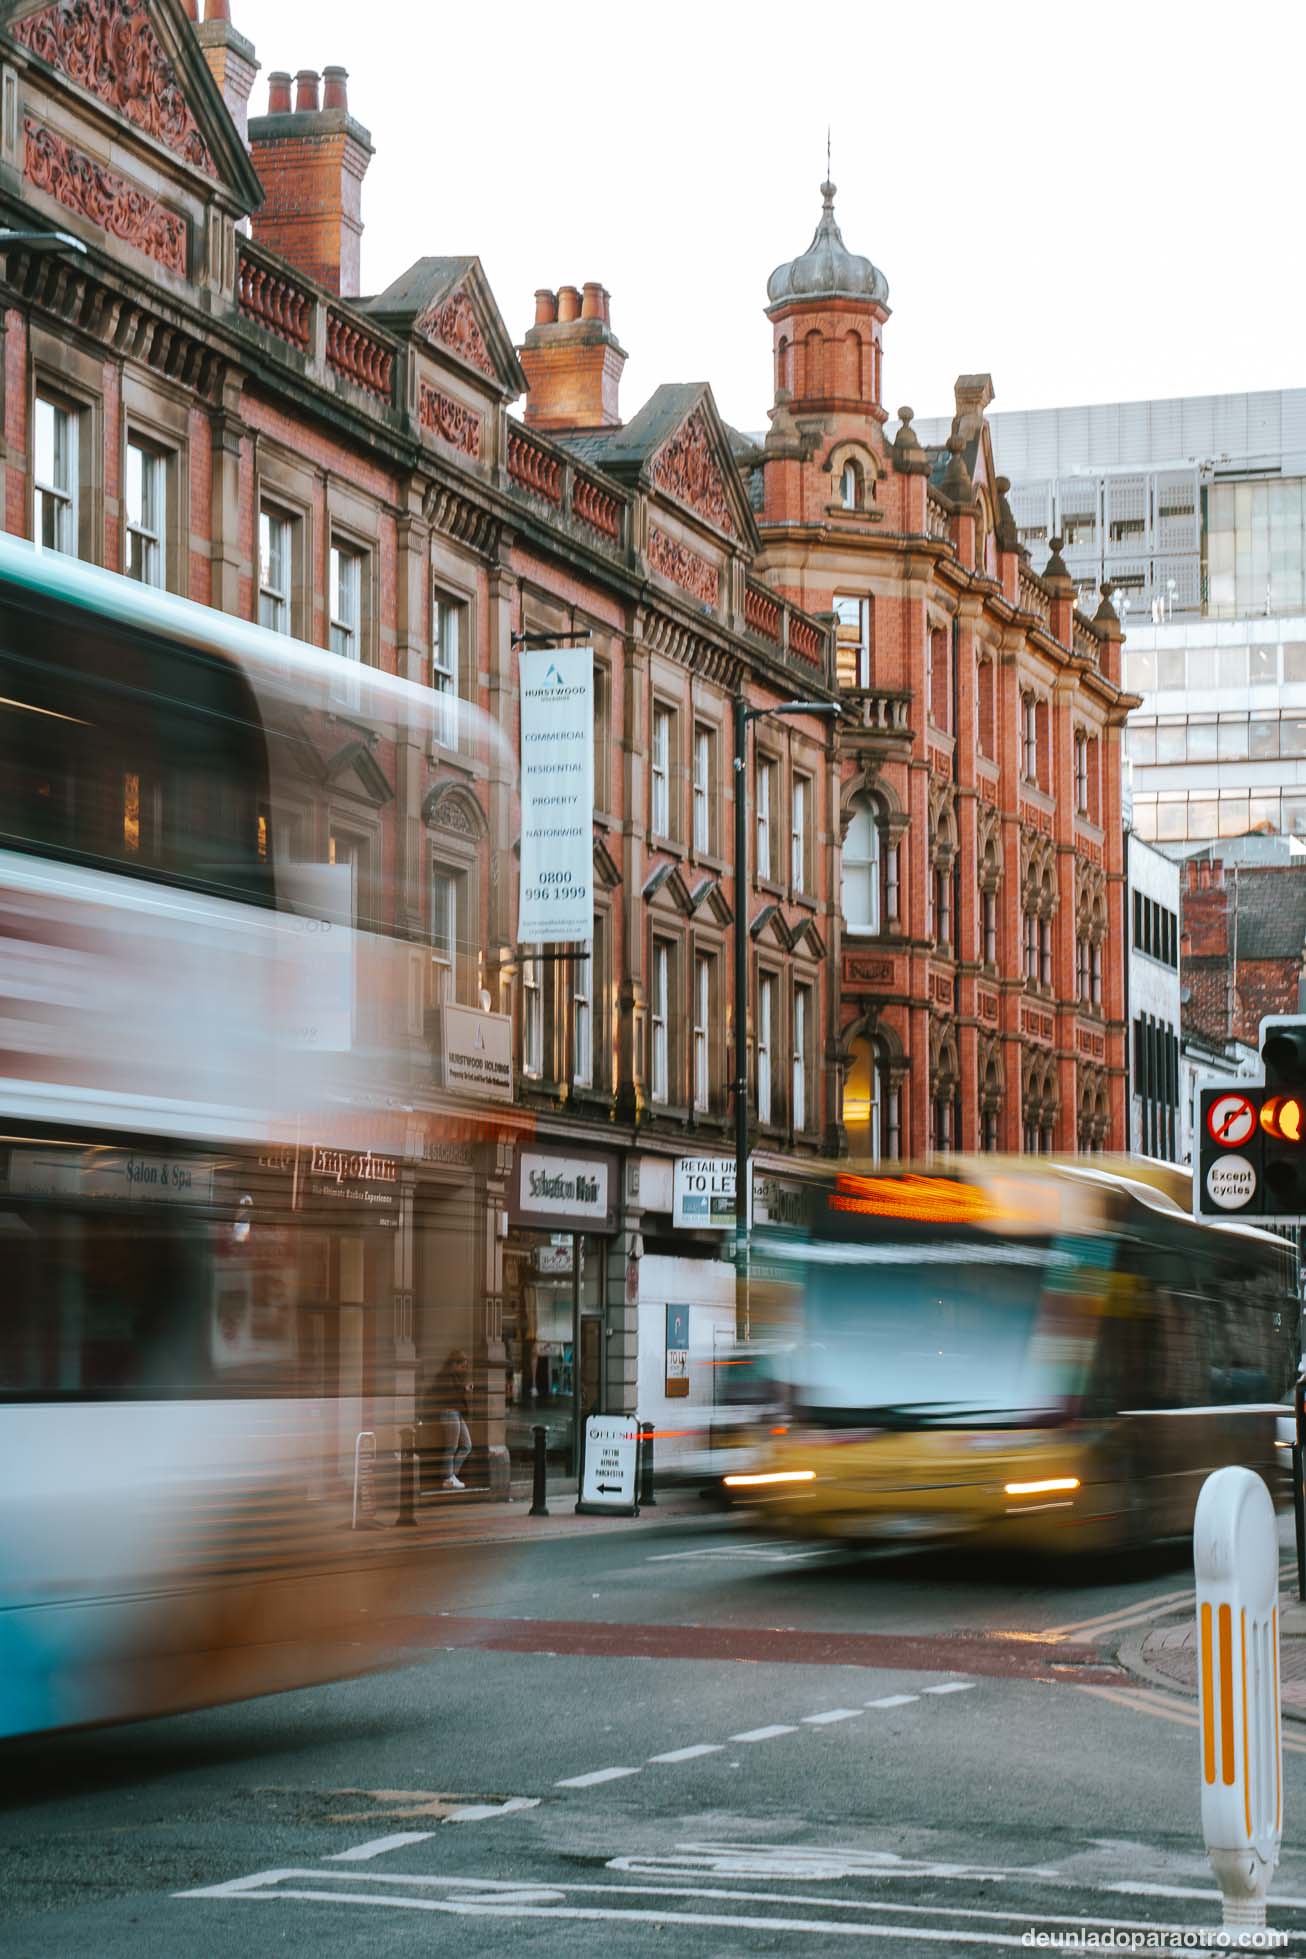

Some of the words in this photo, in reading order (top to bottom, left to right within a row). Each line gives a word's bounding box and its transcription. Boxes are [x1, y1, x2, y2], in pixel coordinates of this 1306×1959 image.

[525, 686, 586, 697] HURSTWOOD
[525, 731, 585, 743] COMMERCIAL
[526, 763, 583, 775] RESIDENTIAL
[531, 795, 578, 807] PROPERTY
[526, 827, 584, 838] NATIONWIDE
[539, 871, 572, 885] 0800
[525, 887, 549, 901] 996
[553, 886, 586, 900] 1999
[681, 1159, 716, 1172] RETAIL
[721, 1160, 737, 1173] UN
[126, 1160, 158, 1185] Salon
[160, 1165, 169, 1185] &
[172, 1166, 192, 1191] Spa
[1211, 1169, 1252, 1182] Except
[686, 1175, 707, 1192] TO
[1213, 1183, 1250, 1196] cycles
[364, 1191, 392, 1205] Experience
[670, 1351, 678, 1364] TO
